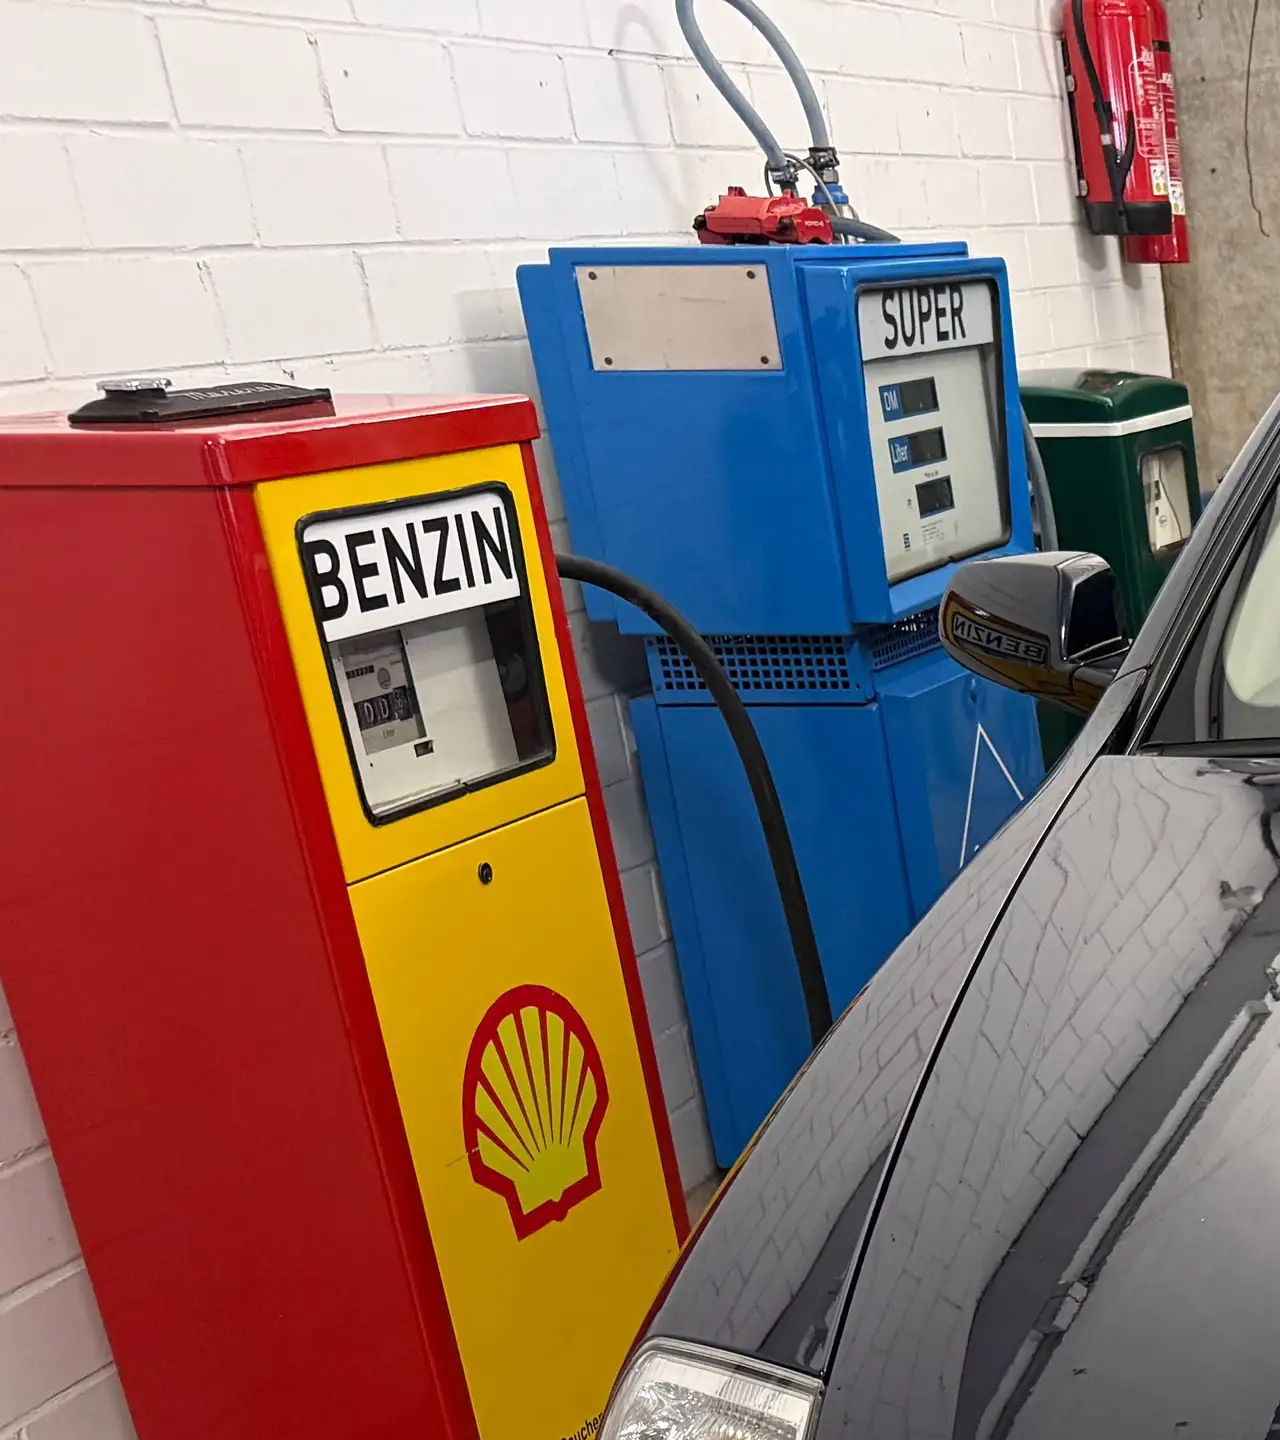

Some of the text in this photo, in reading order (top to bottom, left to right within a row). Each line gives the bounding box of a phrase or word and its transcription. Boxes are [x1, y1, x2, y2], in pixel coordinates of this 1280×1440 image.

[881, 284, 966, 350] SUPER
[883, 390, 899, 412] DM
[304, 507, 513, 624] BENZIN
